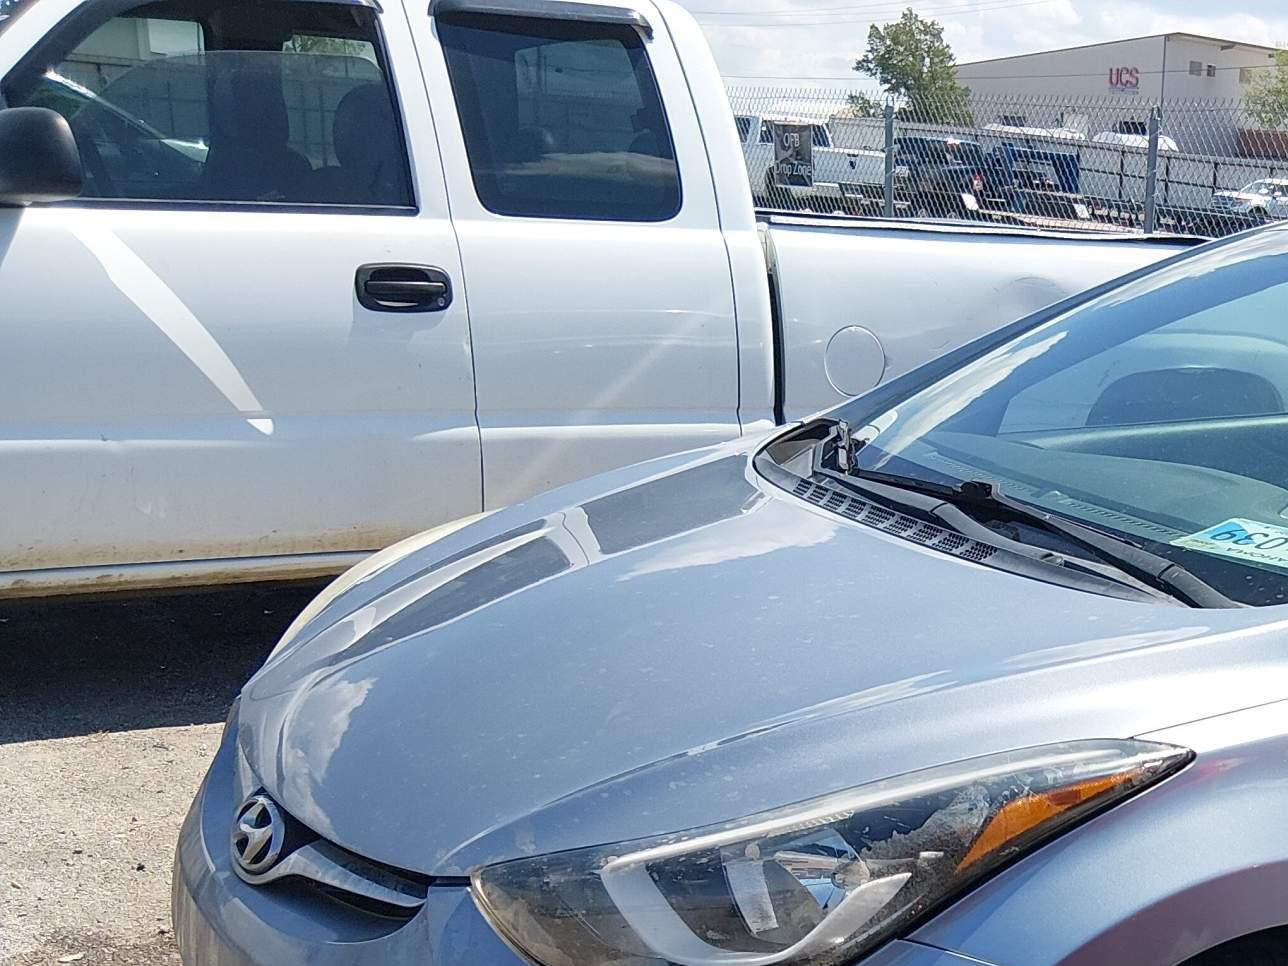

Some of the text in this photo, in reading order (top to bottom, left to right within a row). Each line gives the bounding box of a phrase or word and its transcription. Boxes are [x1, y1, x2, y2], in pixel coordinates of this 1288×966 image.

[1109, 67, 1139, 87] UCS
[774, 161, 812, 176] Drop Zone
